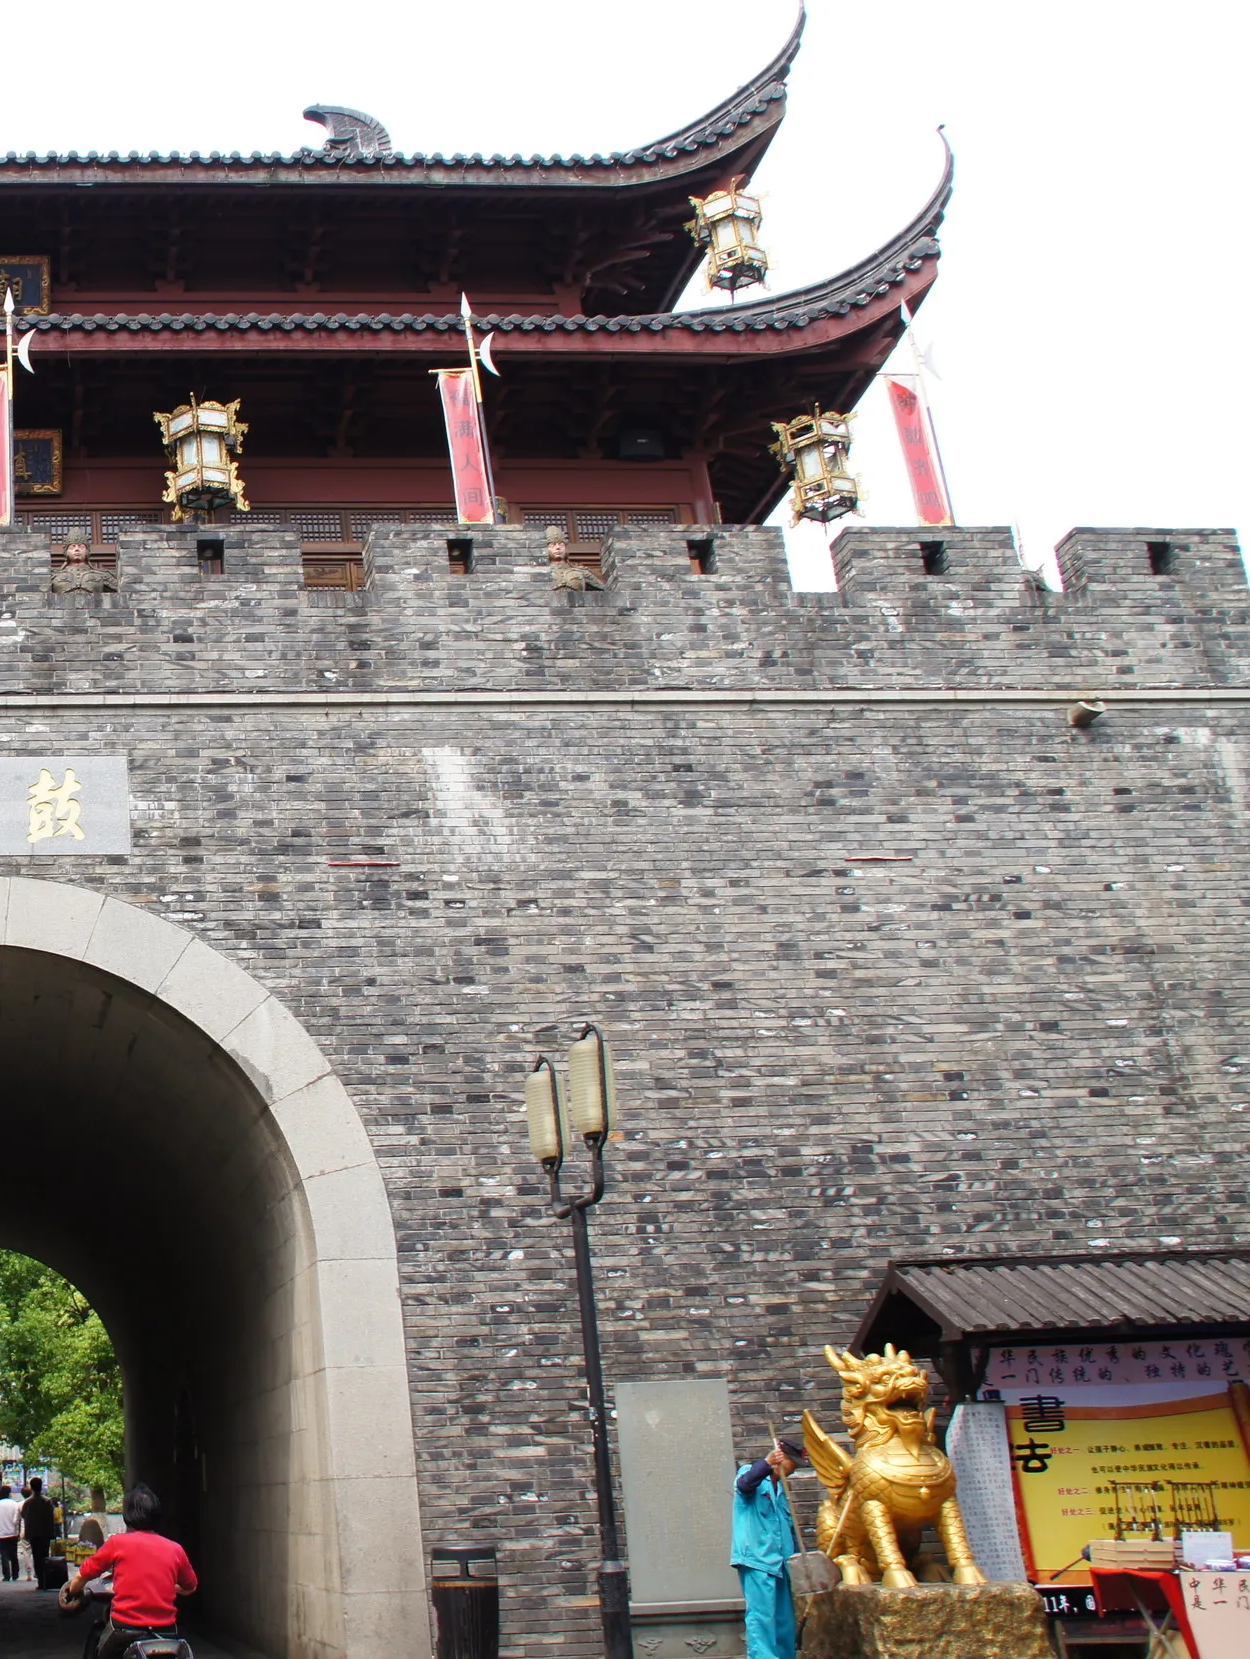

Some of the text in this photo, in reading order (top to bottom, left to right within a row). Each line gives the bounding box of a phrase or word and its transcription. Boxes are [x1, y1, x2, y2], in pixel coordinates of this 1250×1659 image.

[990, 1341, 1250, 1366] 华民族优秀的文化瑰
[980, 1361, 1250, 1387] 一门传统的、独特的艺
